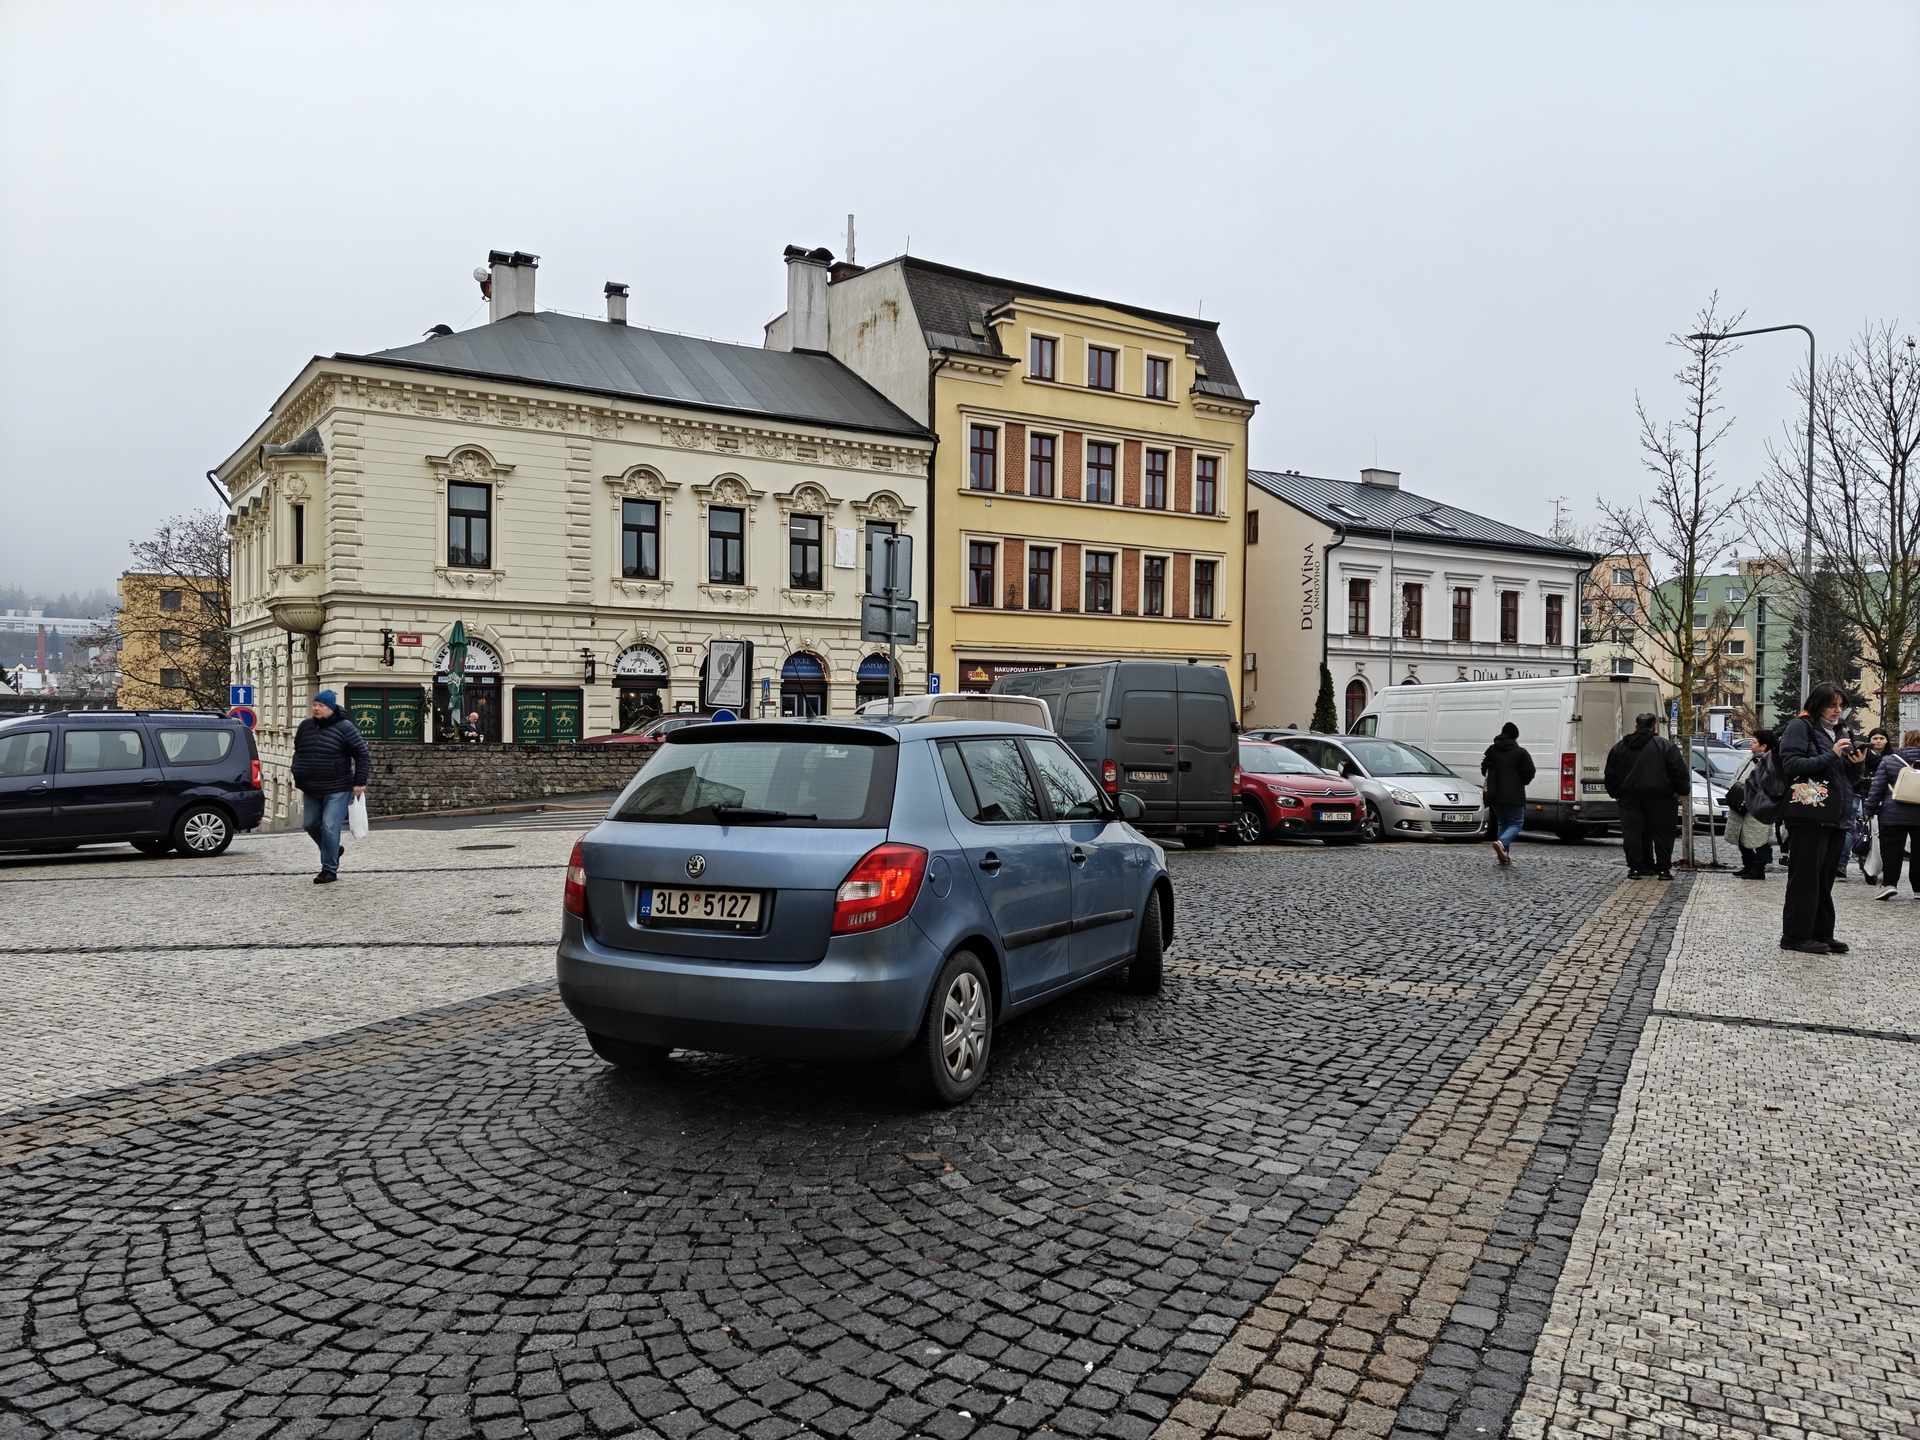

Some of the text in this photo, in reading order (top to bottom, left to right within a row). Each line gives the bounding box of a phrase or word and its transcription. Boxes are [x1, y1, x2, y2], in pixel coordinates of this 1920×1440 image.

[1301, 543, 1314, 630] DŮM VÍNA
[932, 677, 938, 692] P
[1134, 772, 1165, 780] 6L3 3114
[1336, 812, 1350, 820] 0292
[655, 891, 752, 918] 3L8 5127
